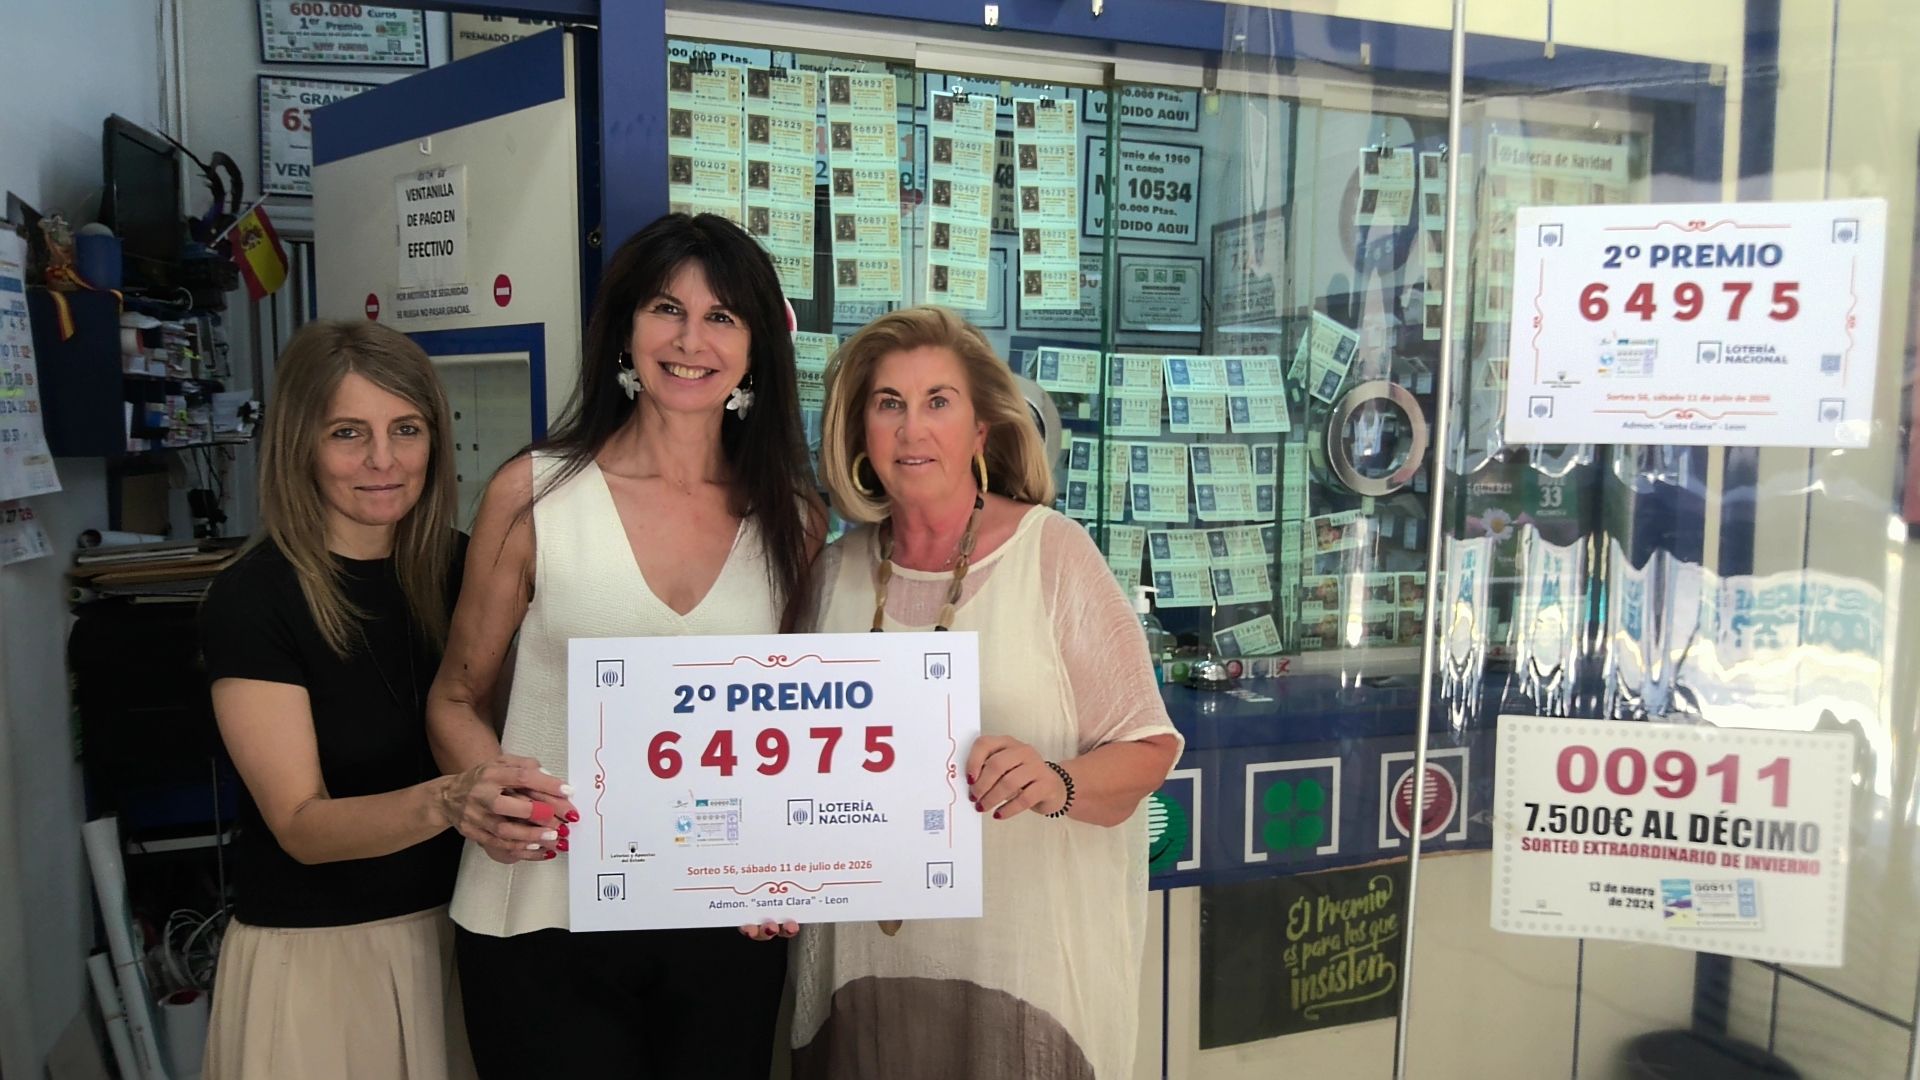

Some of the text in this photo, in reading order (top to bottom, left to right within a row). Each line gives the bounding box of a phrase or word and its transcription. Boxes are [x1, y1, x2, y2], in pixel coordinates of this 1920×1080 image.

[405, 182, 455, 202] VENTANILLA
[1128, 178, 1193, 203] 10534
[407, 209, 456, 227] DE PAGO EN
[1157, 223, 1189, 235] AQUI
[408, 239, 454, 258] EFECTIVO
[1602, 244, 1783, 269] 2º PREMIO
[674, 681, 873, 713] 2º PREMIO
[1556, 744, 1793, 808] 00911
[818, 800, 874, 813] LOTERÍA
[818, 814, 888, 824] NACIONAL
[1523, 802, 1822, 855] 7.500€ AL DÉCIMO
[1521, 836, 1821, 876] SORTEO EXTRAORDINARIO DE INVIERNO
[687, 860, 873, 877] Sorteo 56, sábado 11 de julio de 2026
[1603, 884, 1617, 894] de
[1620, 886, 1655, 897] enero
[709, 900, 748, 910] Admon.
[751, 897, 783, 908] "santa
[786, 896, 816, 907] Clara"
[825, 895, 849, 906] Leon
[1317, 874, 1395, 933] Premio
[1608, 897, 1622, 907] de
[1302, 933, 1342, 971] para
[1344, 920, 1367, 947] los
[1368, 913, 1400, 951] que
[1290, 946, 1388, 1010] insisten
